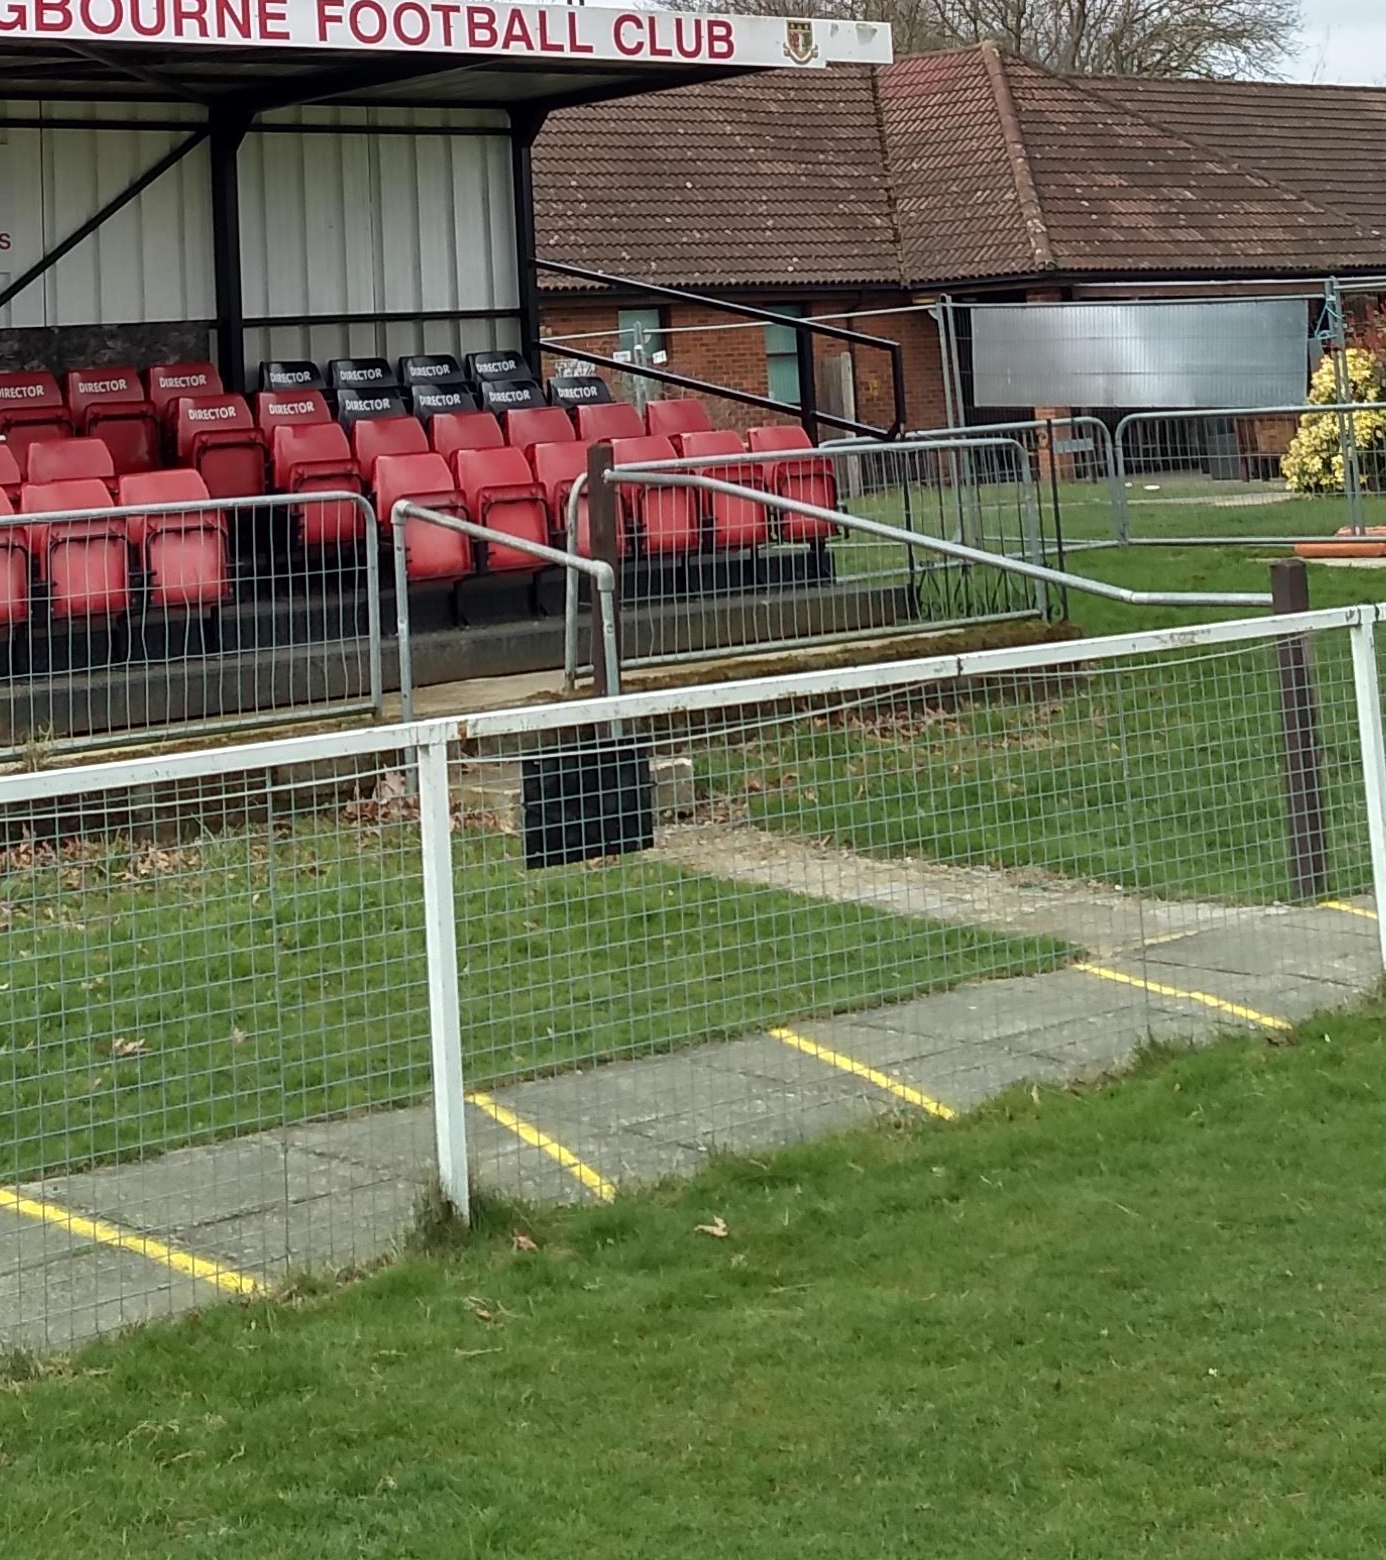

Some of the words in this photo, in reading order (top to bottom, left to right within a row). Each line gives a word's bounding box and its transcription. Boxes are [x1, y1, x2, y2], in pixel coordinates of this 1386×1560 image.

[612, 13, 735, 60] CLUB
[409, 363, 451, 378] DIRECTOR
[476, 359, 517, 374] DIRECTOR
[159, 374, 207, 389] DIRECTOR
[269, 370, 312, 384] DIRECTOR
[339, 367, 383, 382] DIRECTOR
[78, 378, 127, 394] DIRECTOR
[557, 385, 599, 399] DIRECTOR
[418, 392, 461, 407] DIRECTOR
[489, 389, 532, 403] DIRECTOR
[268, 400, 315, 416] DIRECTOR
[345, 397, 391, 412] DIRECTOR
[188, 405, 237, 421] DIRECTOR
